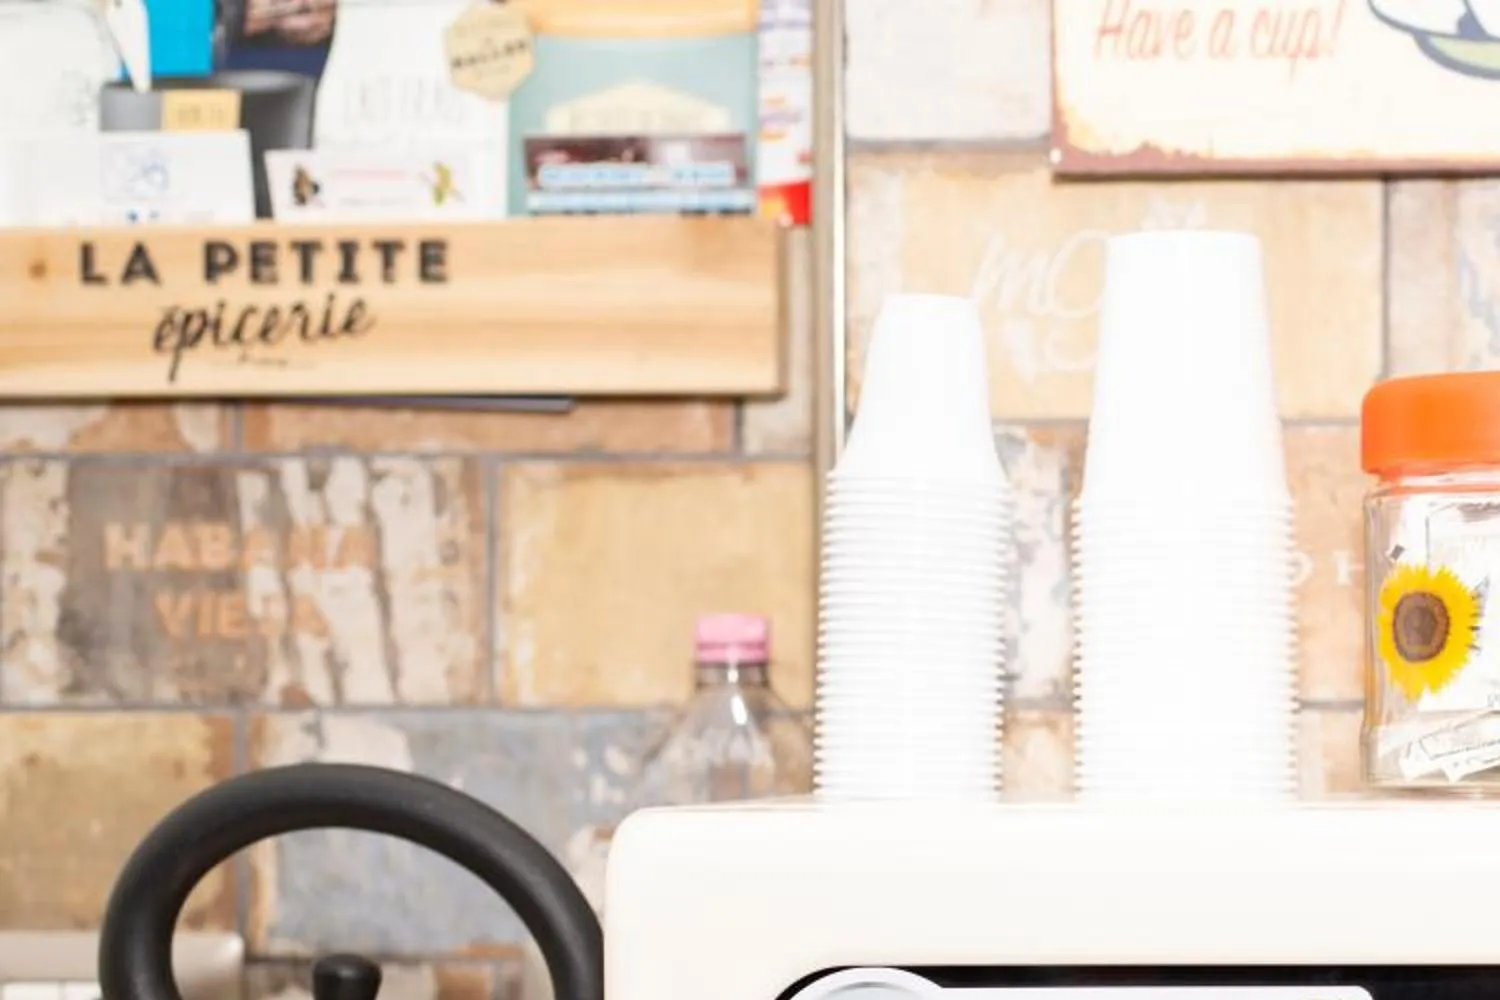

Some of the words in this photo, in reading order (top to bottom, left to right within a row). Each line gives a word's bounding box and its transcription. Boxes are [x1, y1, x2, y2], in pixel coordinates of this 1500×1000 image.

[1094, 0, 1199, 60] Have
[1208, 8, 1236, 60] a
[78, 240, 162, 285] LA
[202, 240, 451, 285] PETITE
[104, 519, 379, 570] HABANA
